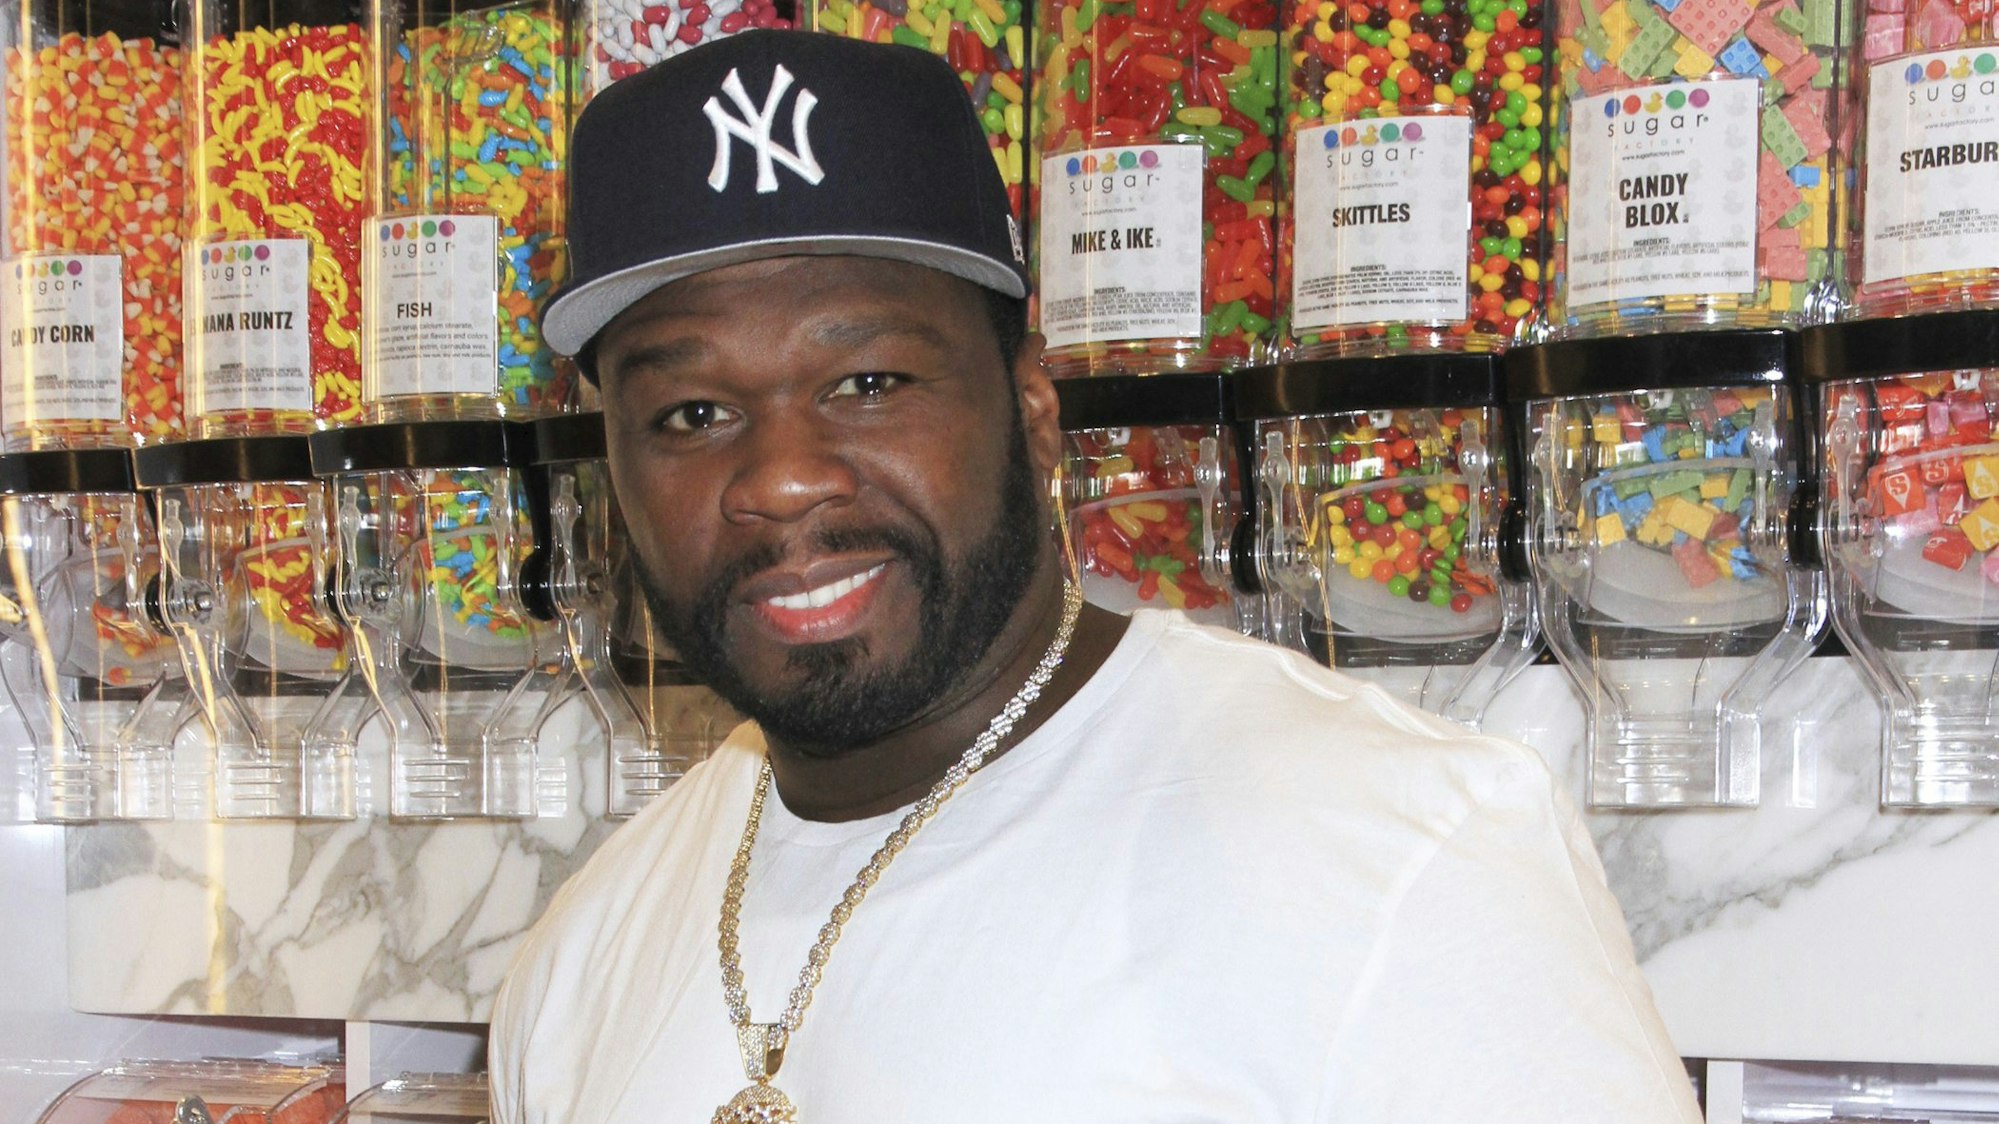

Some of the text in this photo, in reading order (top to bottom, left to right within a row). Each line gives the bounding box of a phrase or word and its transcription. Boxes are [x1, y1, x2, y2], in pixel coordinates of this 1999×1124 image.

[702, 63, 826, 194] NY
[1607, 113, 1704, 138] sugar
[1326, 147, 1417, 169] sugar
[1900, 142, 1999, 173] STARBUR
[1069, 173, 1154, 195] sugar
[1619, 173, 1688, 202] CANDY
[1332, 203, 1411, 228] SKITTLES
[1625, 202, 1679, 228] BLOX
[381, 241, 452, 259] sugar
[1072, 227, 1154, 254] MIKE & IKE
[240, 312, 293, 331] RUNTZ
[397, 302, 432, 319] FISH
[51, 325, 94, 343] CORN
